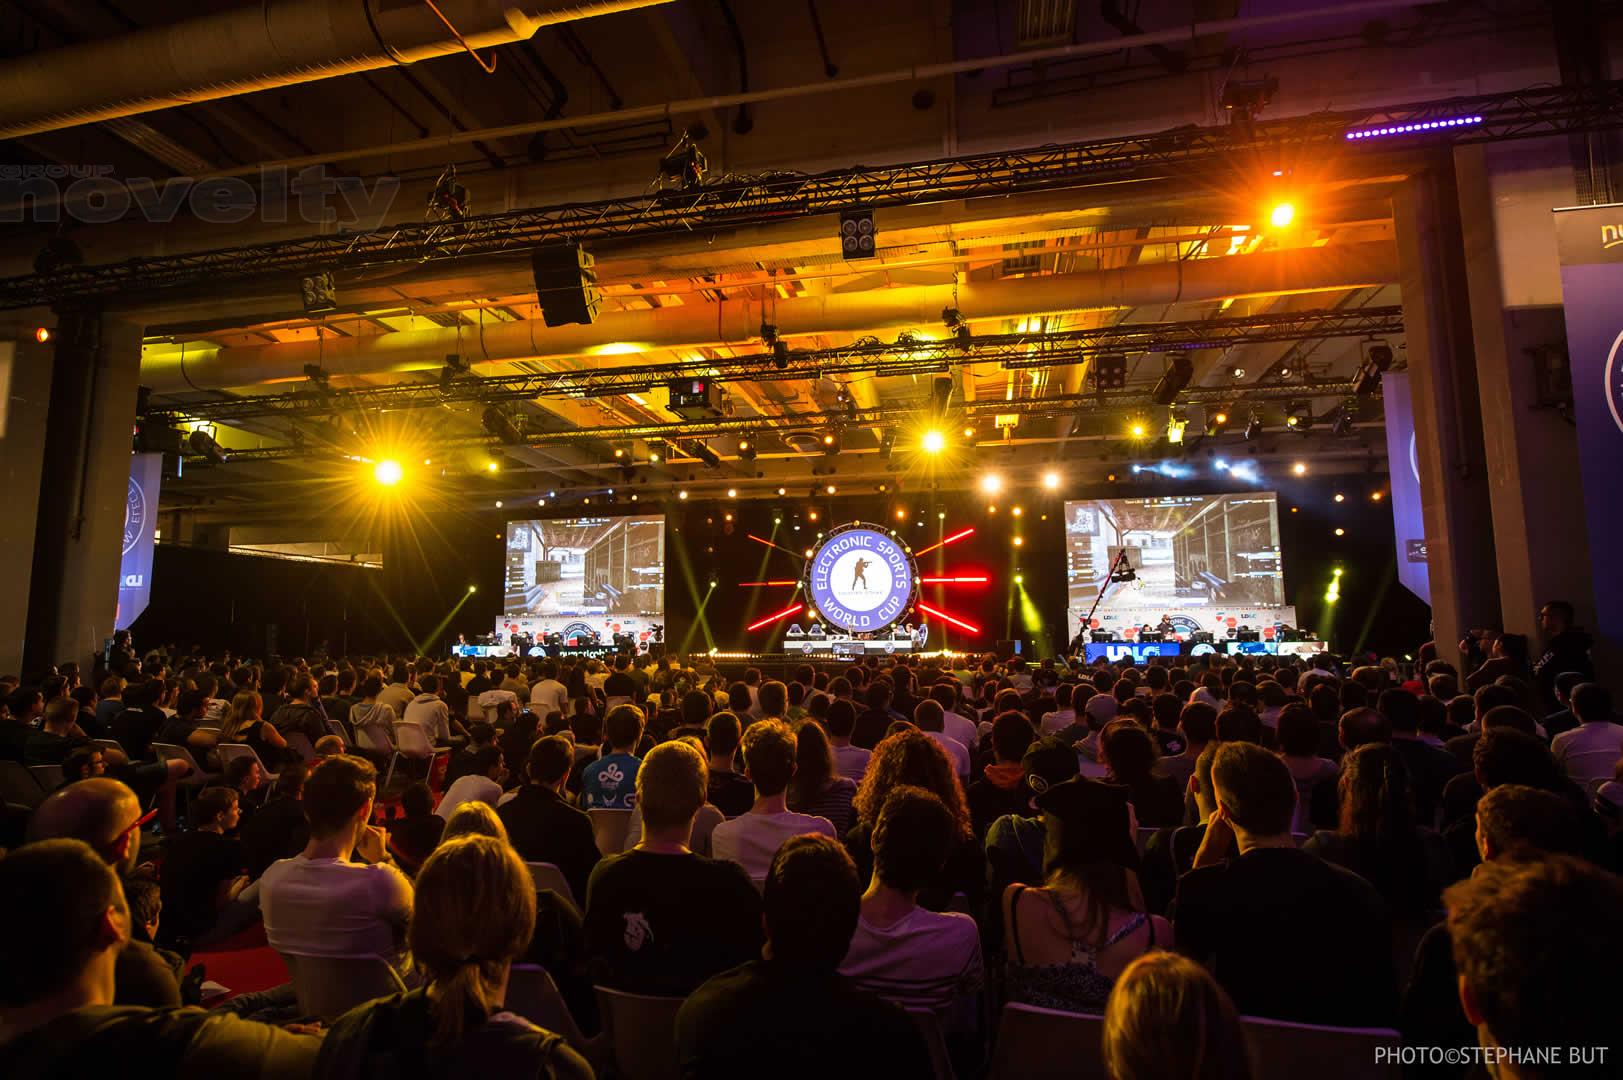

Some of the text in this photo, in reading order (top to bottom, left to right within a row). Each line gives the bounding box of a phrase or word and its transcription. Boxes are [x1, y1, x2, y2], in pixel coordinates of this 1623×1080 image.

[816, 535, 907, 591] ELECTRONIC SPORTS
[823, 596, 900, 627] WORLD CUP
